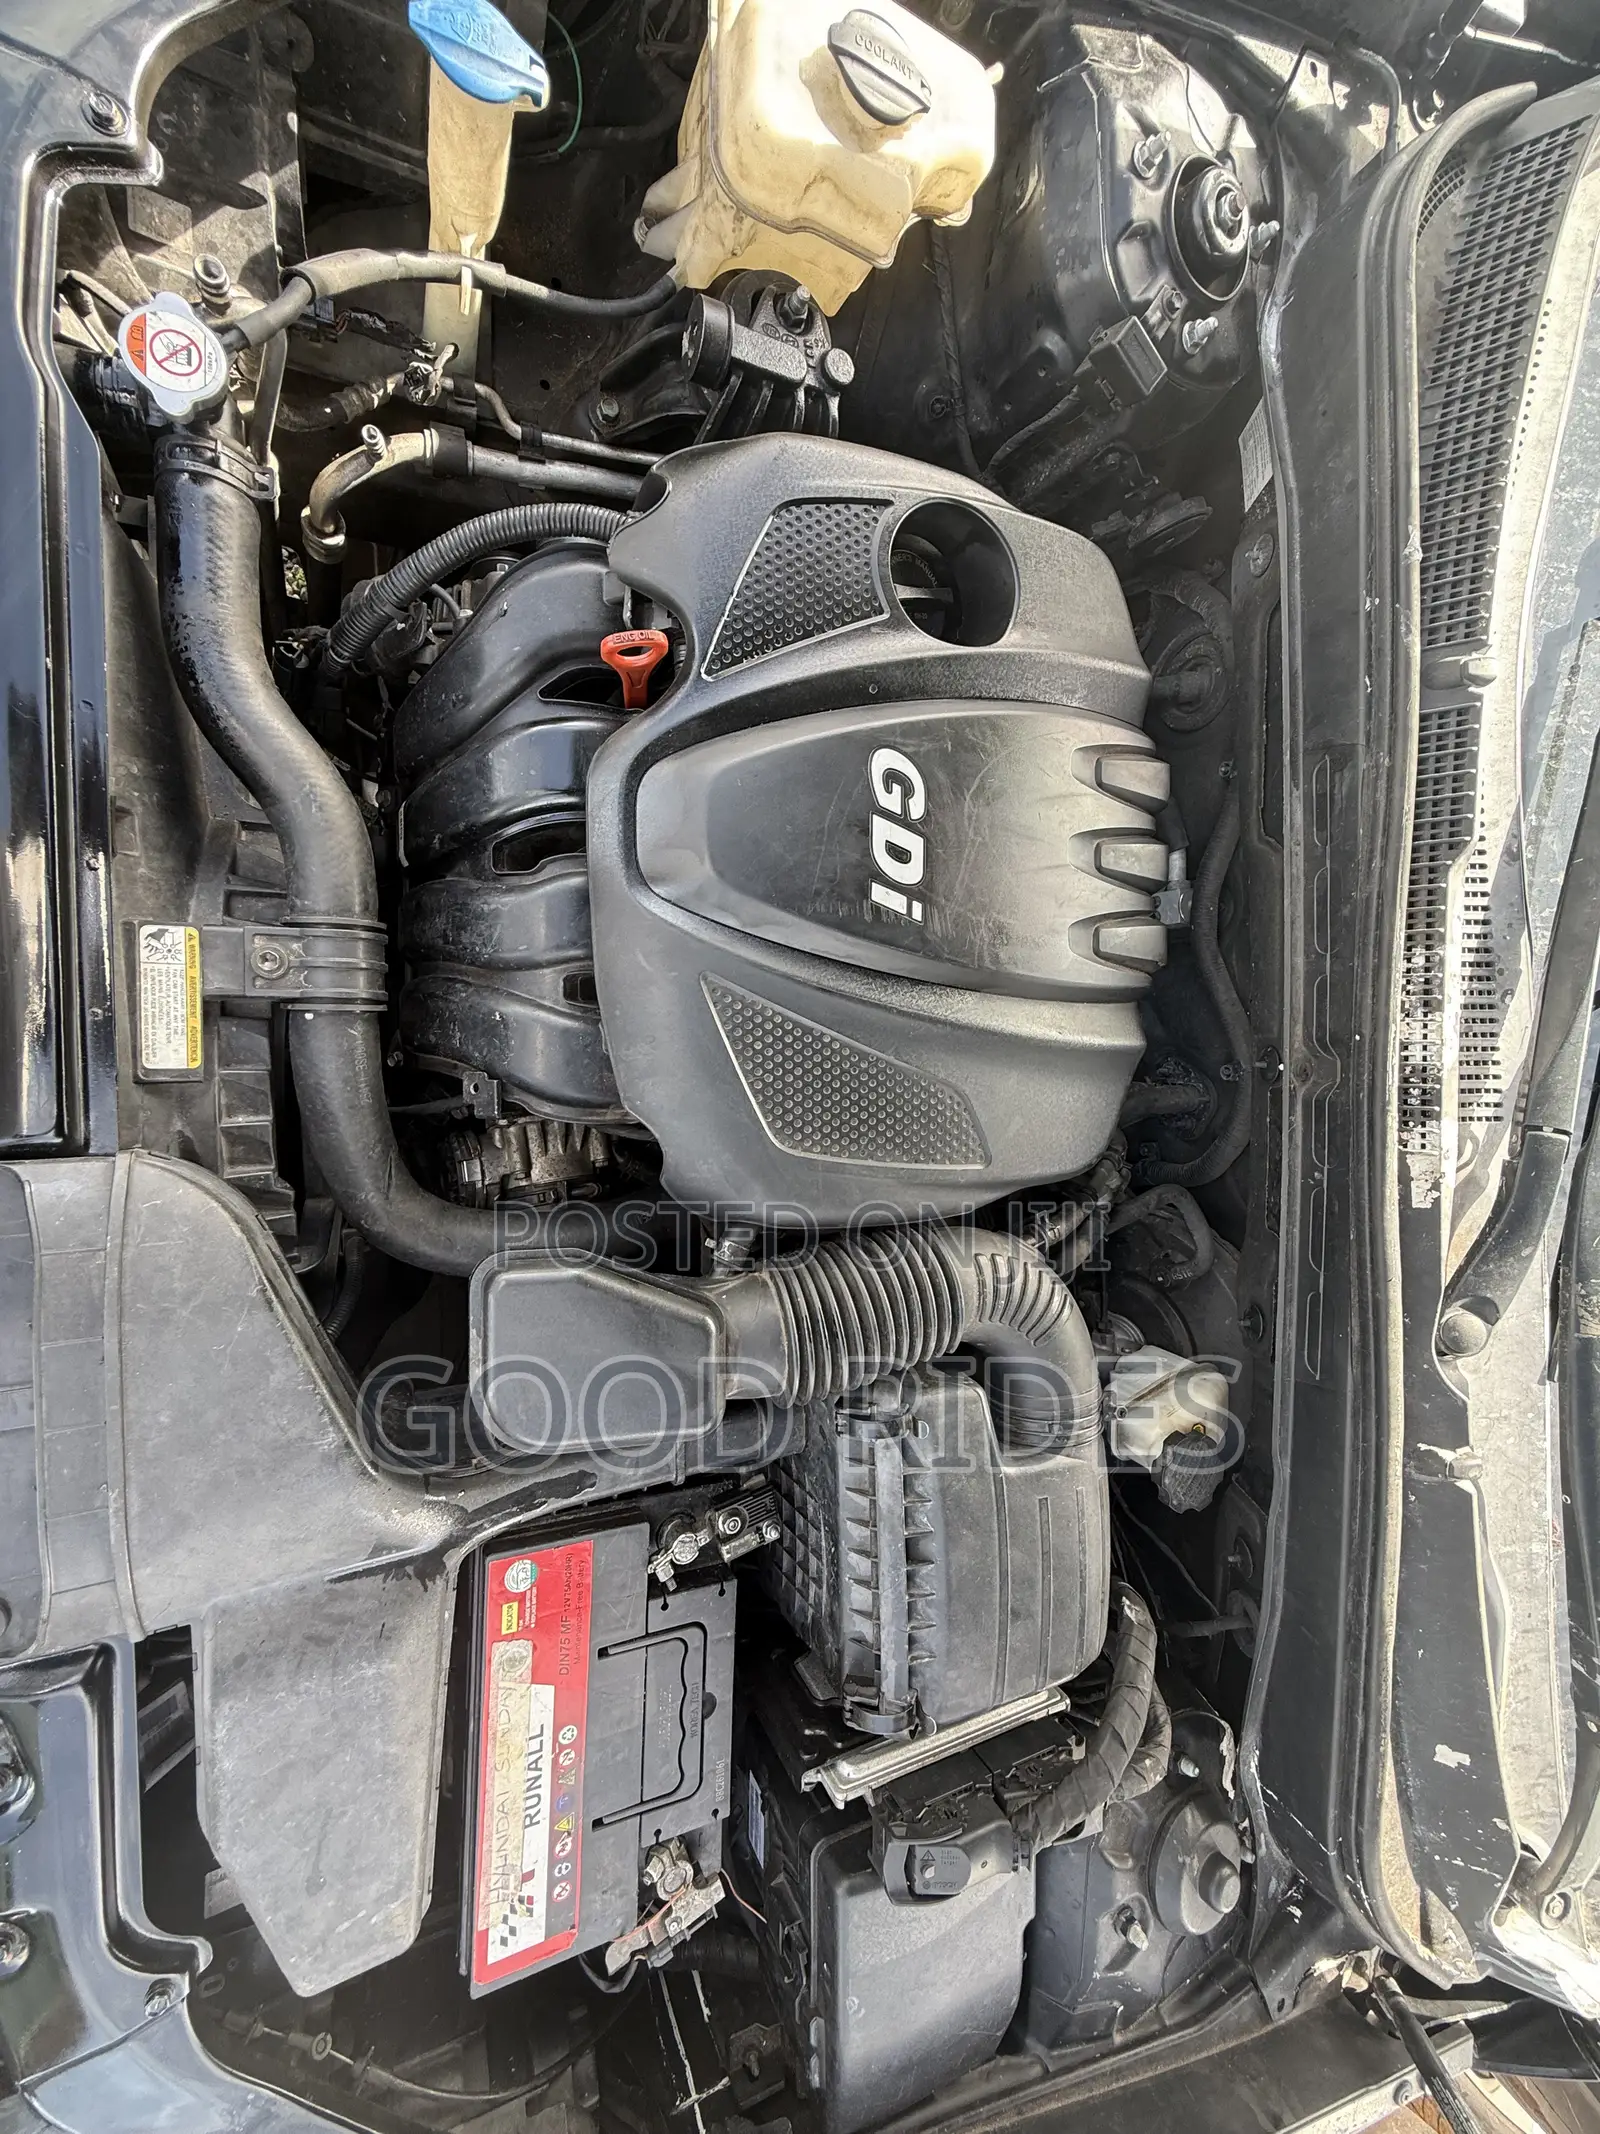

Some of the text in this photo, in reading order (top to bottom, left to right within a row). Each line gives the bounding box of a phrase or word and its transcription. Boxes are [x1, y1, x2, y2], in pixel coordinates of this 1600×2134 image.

[854, 33, 915, 80] COOLANT
[613, 631, 655, 645] ENG OIL
[867, 746, 928, 926] GDi
[188, 944, 199, 1063] WARNING AVERTISSEMENT ADVERTENCIA
[505, 1603, 515, 1632] INDICATOR
[560, 1615, 571, 1635] MF
[559, 1638, 570, 1676] DIN75
[485, 1685, 517, 1906] HYUNDAI SUNDAY
[523, 1724, 545, 1828] RUNALL
